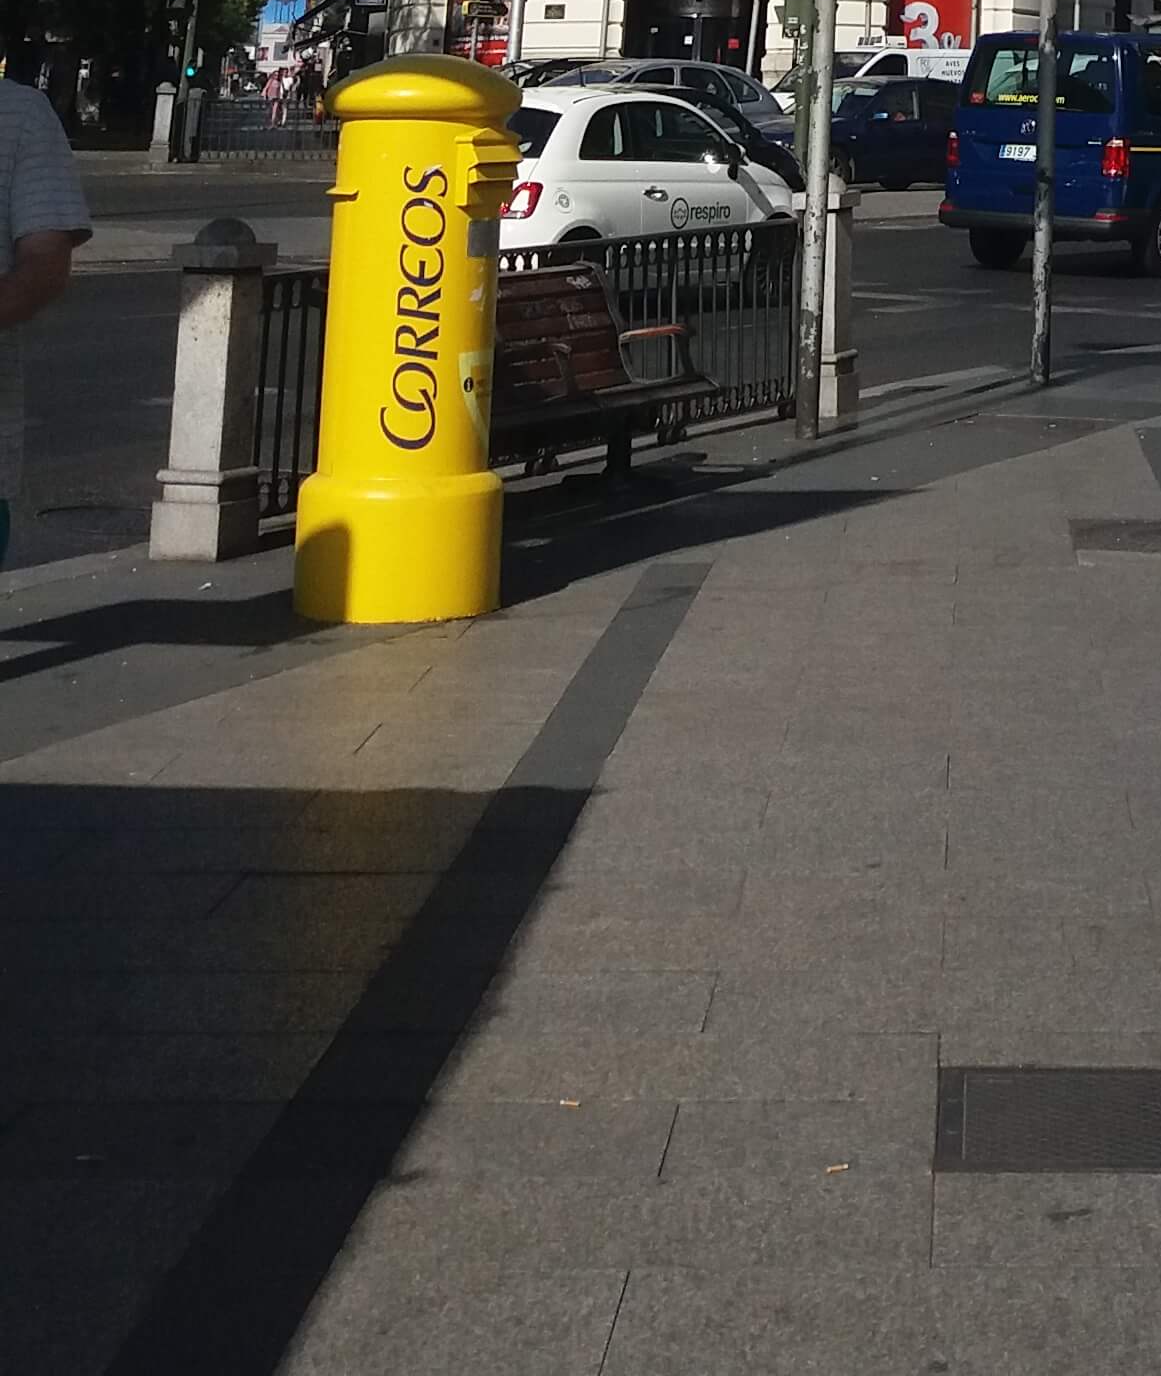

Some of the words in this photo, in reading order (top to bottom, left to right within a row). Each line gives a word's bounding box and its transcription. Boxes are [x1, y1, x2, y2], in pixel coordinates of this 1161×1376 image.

[1006, 146, 1031, 158] 9197
[690, 201, 731, 224] respiro
[380, 164, 449, 451] CORREOS
